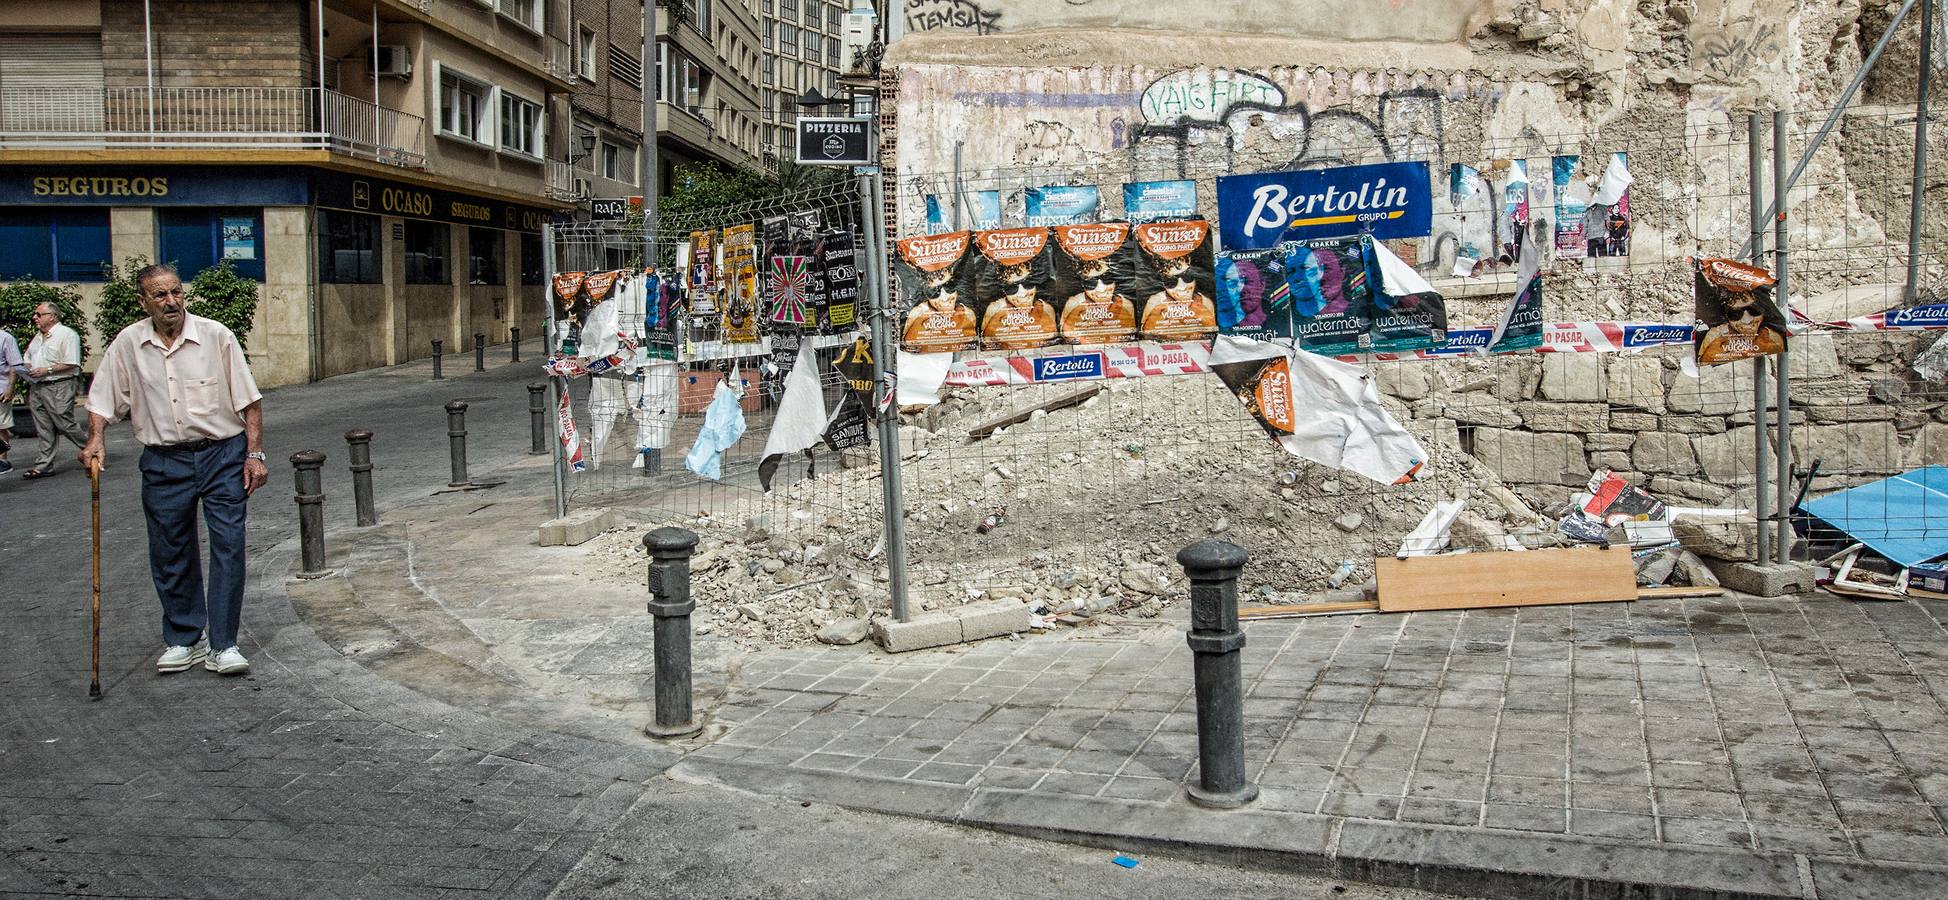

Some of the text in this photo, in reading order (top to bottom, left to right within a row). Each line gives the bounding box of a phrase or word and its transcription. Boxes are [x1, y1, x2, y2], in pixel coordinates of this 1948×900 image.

[806, 123, 862, 133] PIZZERIA
[32, 176, 169, 196] SEGUROS
[381, 187, 432, 216] OCASO
[1243, 178, 1409, 237] Bertolín
[451, 201, 491, 221] SEGUROS
[1357, 211, 1388, 222] GRUPO
[986, 231, 1043, 251] Sunset
[1066, 228, 1121, 245] Sunset
[1146, 226, 1203, 244] Sunset
[908, 236, 963, 258] Sunset
[1310, 240, 1340, 248] KRAKEN
[1232, 252, 1261, 260] KRAKEN
[1001, 317, 1035, 325] VULCANO
[1080, 312, 1114, 321] VULCANO
[1161, 310, 1195, 318] VULCANO
[1375, 311, 1434, 328] watermät
[923, 321, 957, 330] VULCANO
[1298, 316, 1361, 334] watermät
[1447, 331, 1487, 348] ertolín
[1555, 331, 1583, 343] PASAR
[1722, 344, 1760, 352] VULCANO
[951, 369, 965, 380] NO
[967, 366, 994, 379] PASAR
[1147, 354, 1160, 366] NO
[1161, 353, 1190, 365] PASAR
[1269, 371, 1289, 425] Sunset
